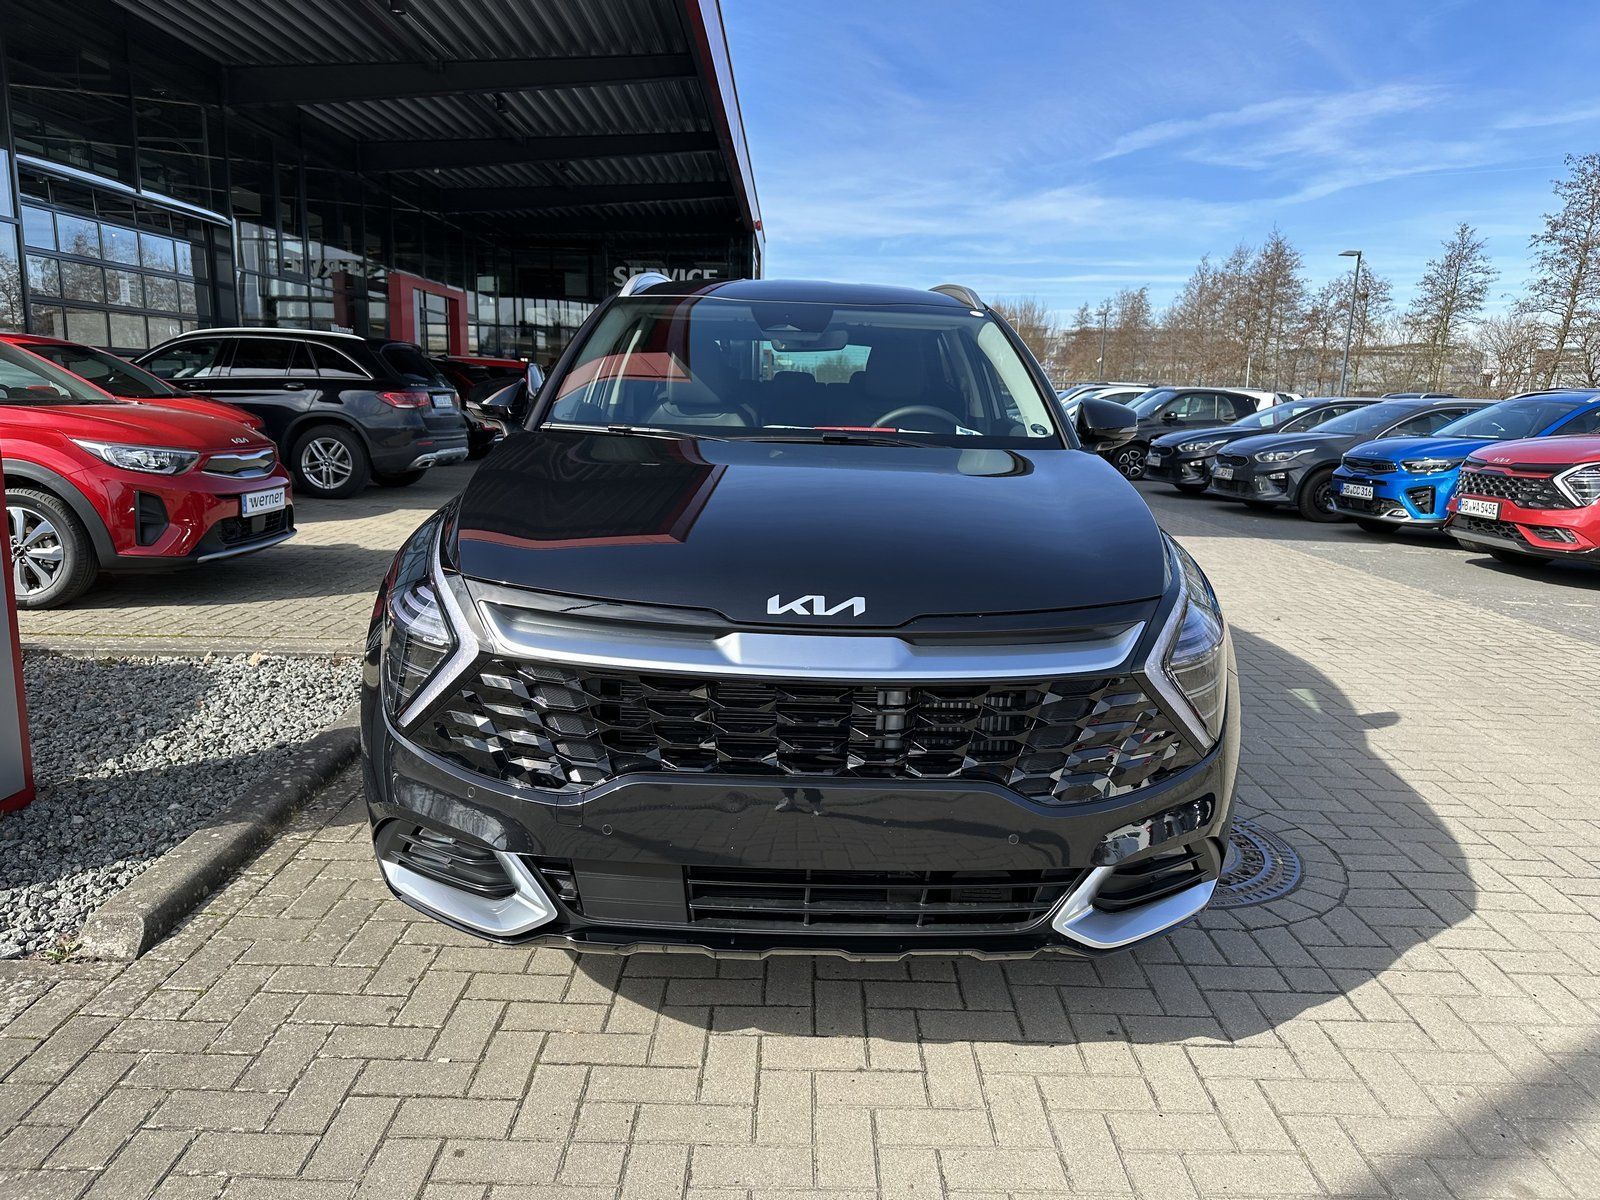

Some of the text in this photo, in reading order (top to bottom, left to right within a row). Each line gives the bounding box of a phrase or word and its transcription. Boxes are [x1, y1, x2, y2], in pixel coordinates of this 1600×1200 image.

[613, 266, 718, 287] SVICE
[249, 491, 284, 508] werner
[767, 594, 866, 617] KIA
